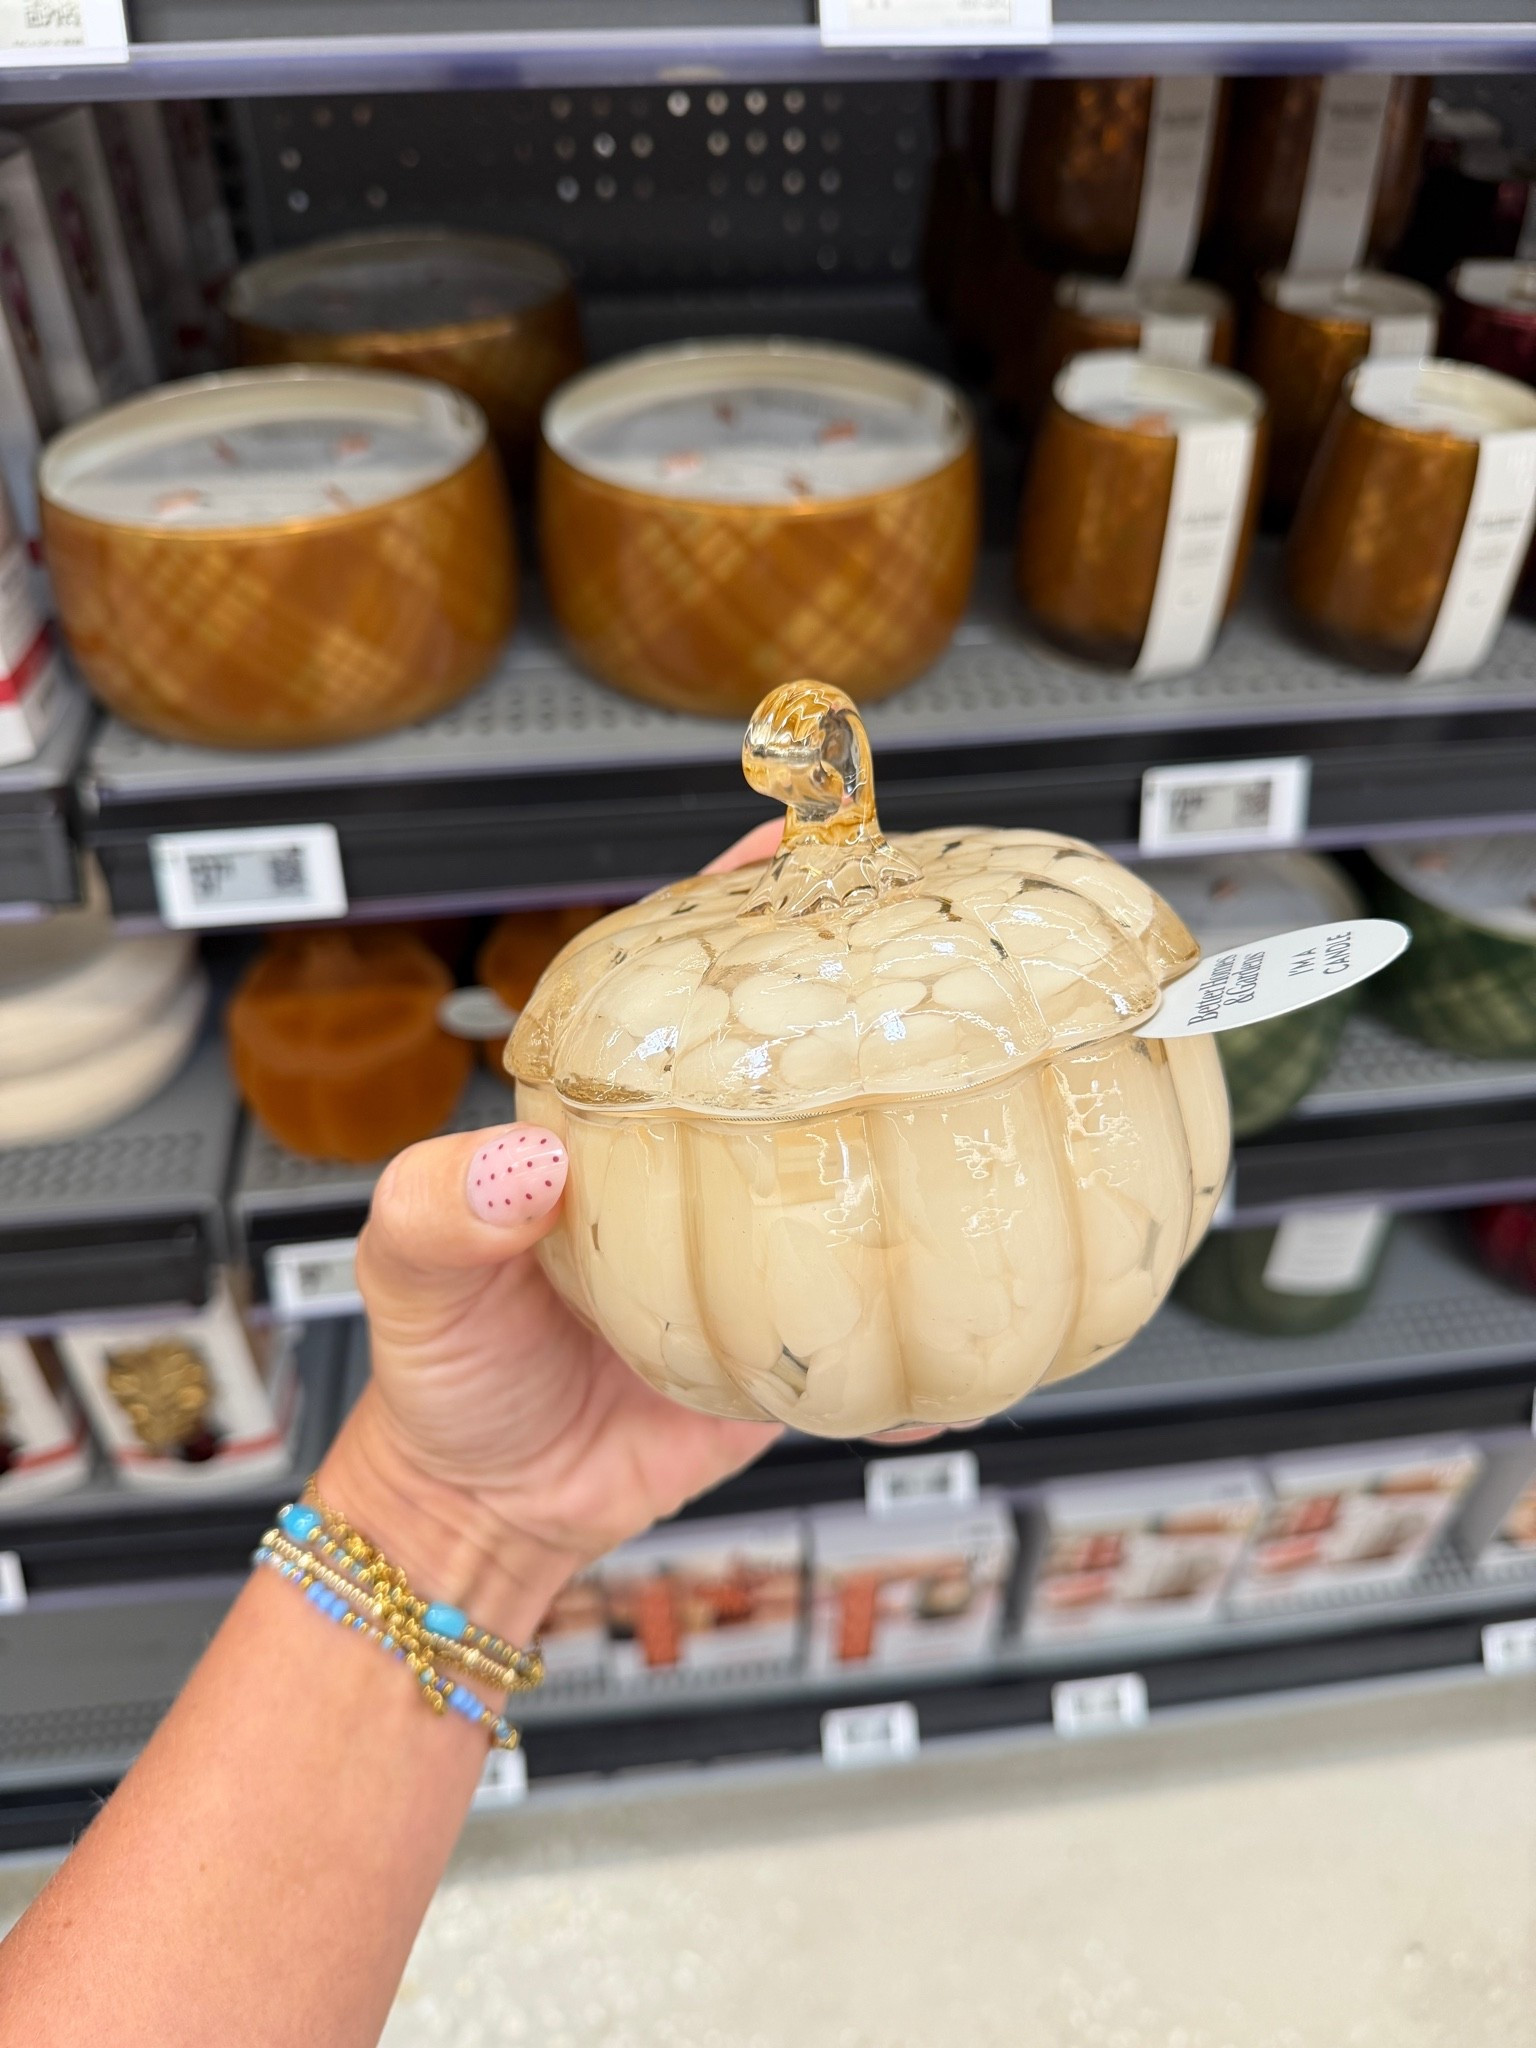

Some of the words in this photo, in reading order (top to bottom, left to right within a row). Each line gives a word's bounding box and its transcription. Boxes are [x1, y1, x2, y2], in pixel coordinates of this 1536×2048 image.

[1288, 957, 1316, 977] I'M
[1291, 947, 1317, 958] A
[1323, 931, 1352, 974] CANDLE
[1199, 954, 1237, 991] Homes
[1187, 986, 1226, 1026] Better
